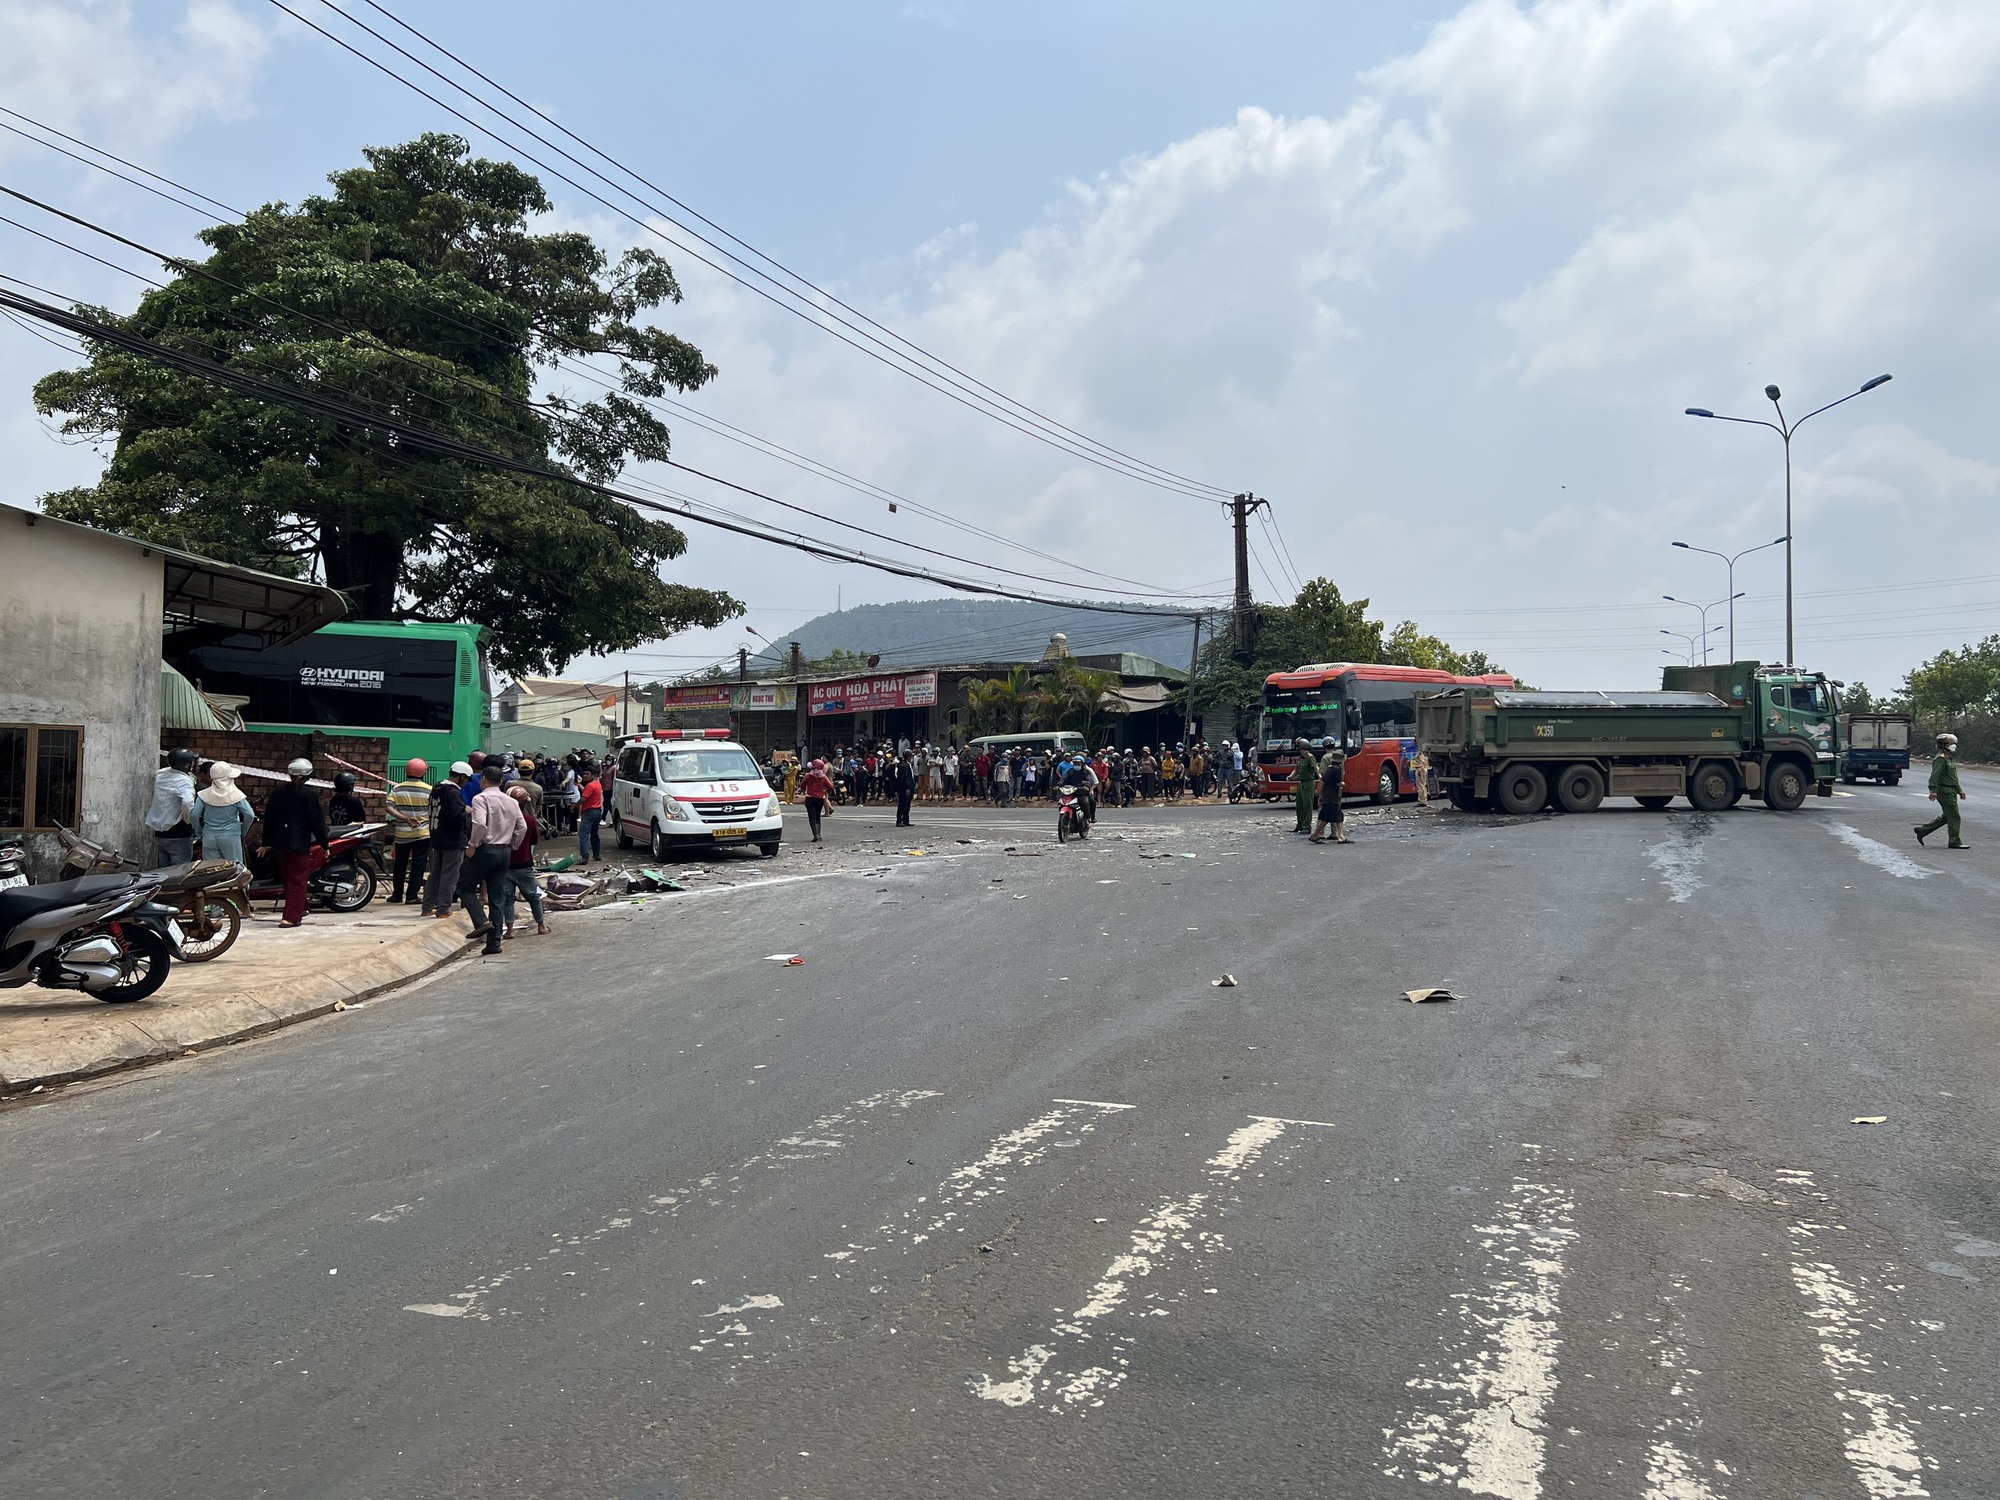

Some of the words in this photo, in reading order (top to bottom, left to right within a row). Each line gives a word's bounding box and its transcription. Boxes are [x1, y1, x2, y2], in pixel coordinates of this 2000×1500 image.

[317, 668, 384, 681] HYUNDAI
[826, 686, 842, 698] QUY
[846, 681, 870, 696] HÒA
[873, 677, 904, 693] PHÁT
[708, 783, 740, 793] 115
